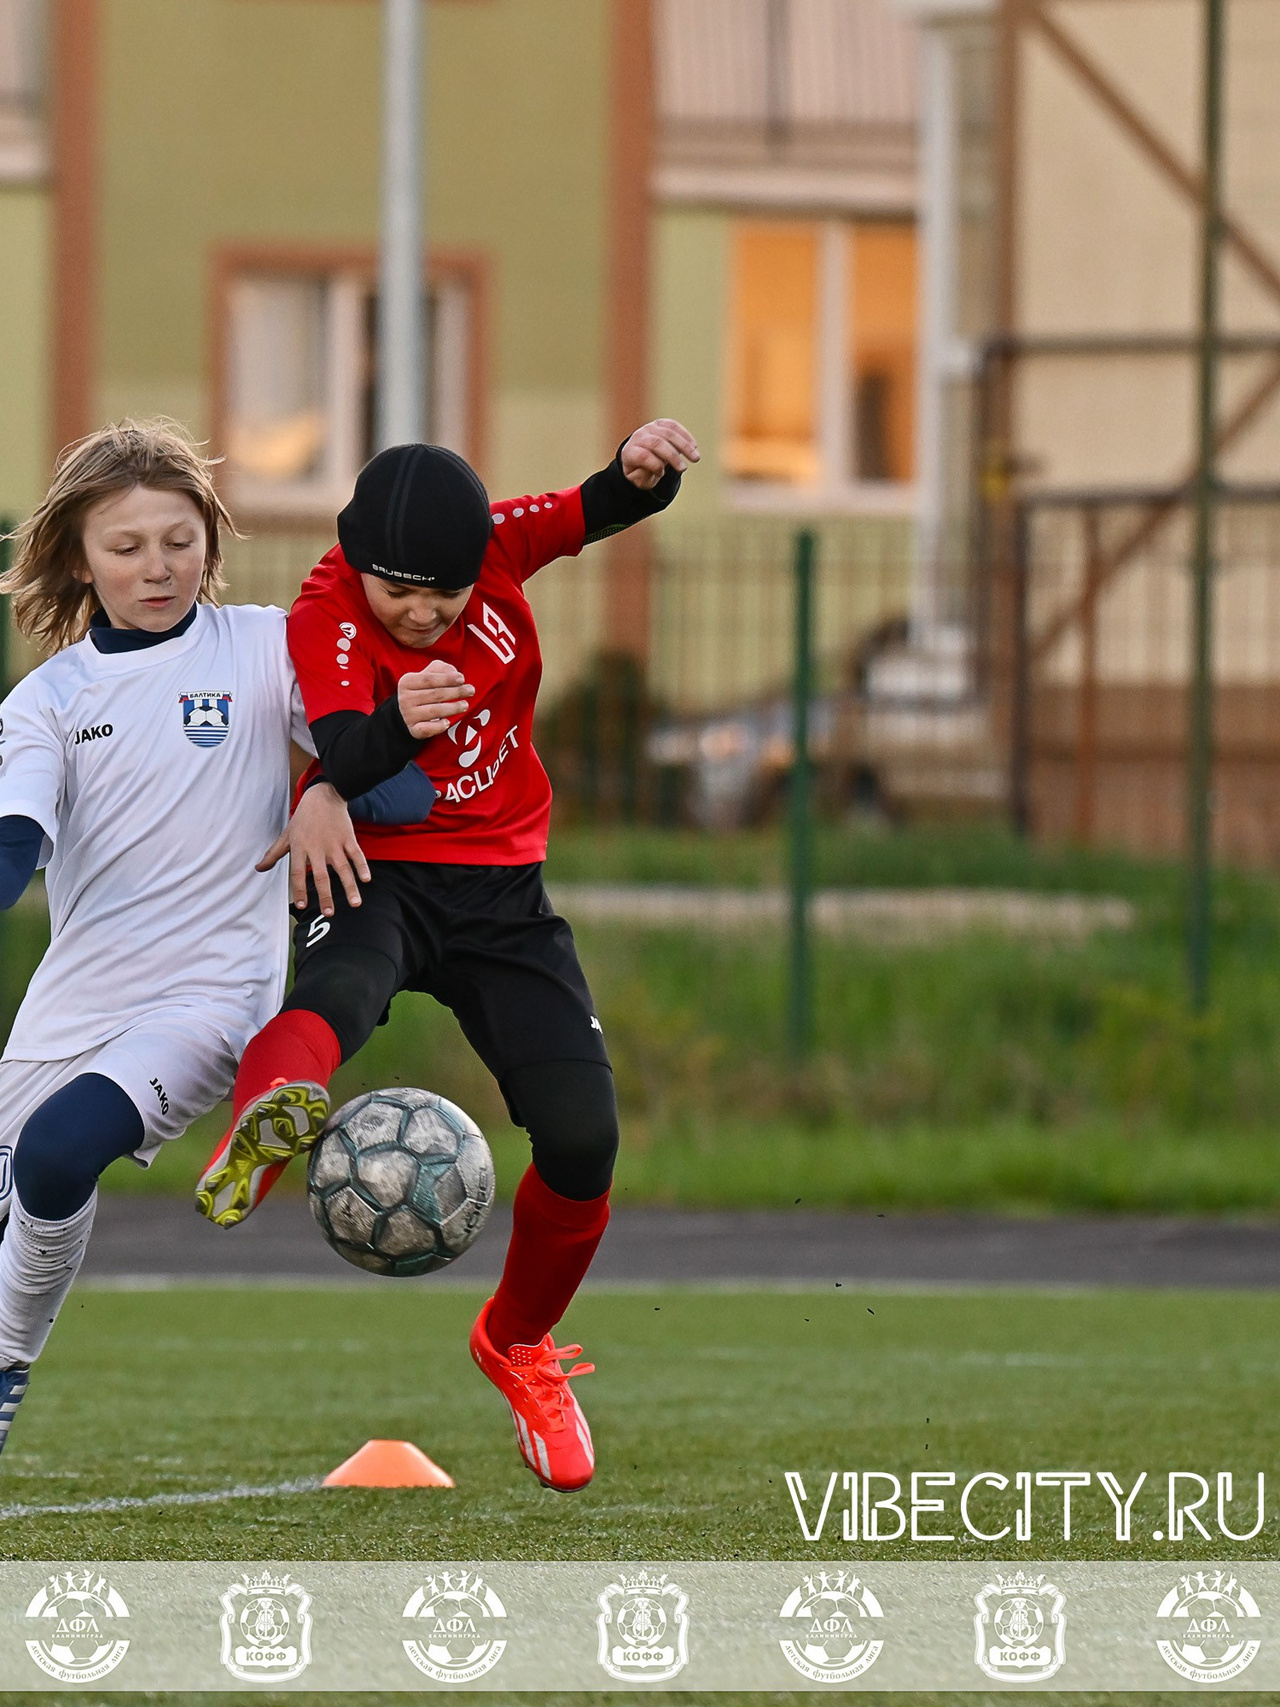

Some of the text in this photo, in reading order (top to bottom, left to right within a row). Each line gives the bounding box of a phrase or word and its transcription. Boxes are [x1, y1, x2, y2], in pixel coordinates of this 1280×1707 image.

[372, 563, 433, 582] BRUBECK
[189, 691, 221, 699] БАЛТИКА
[74, 723, 114, 746] JAKO
[305, 914, 331, 948] 5
[149, 1077, 170, 1116] JAKO
